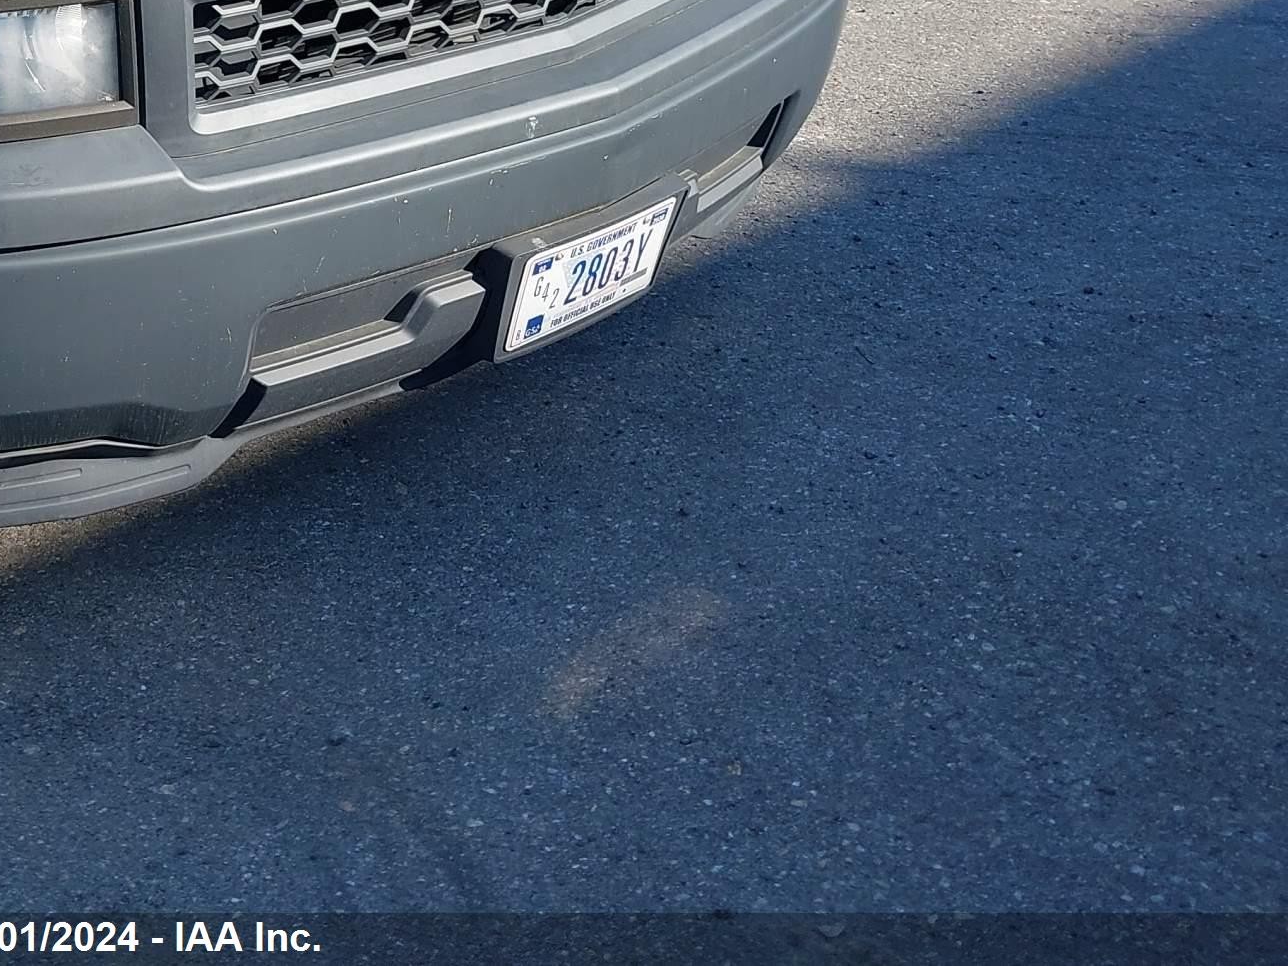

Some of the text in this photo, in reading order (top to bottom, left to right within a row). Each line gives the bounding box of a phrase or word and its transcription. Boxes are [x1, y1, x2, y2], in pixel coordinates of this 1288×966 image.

[570, 222, 638, 258] U.S. GOVERNMENT
[563, 229, 653, 305] 2803Y
[563, 304, 589, 322] OFFICIAL
